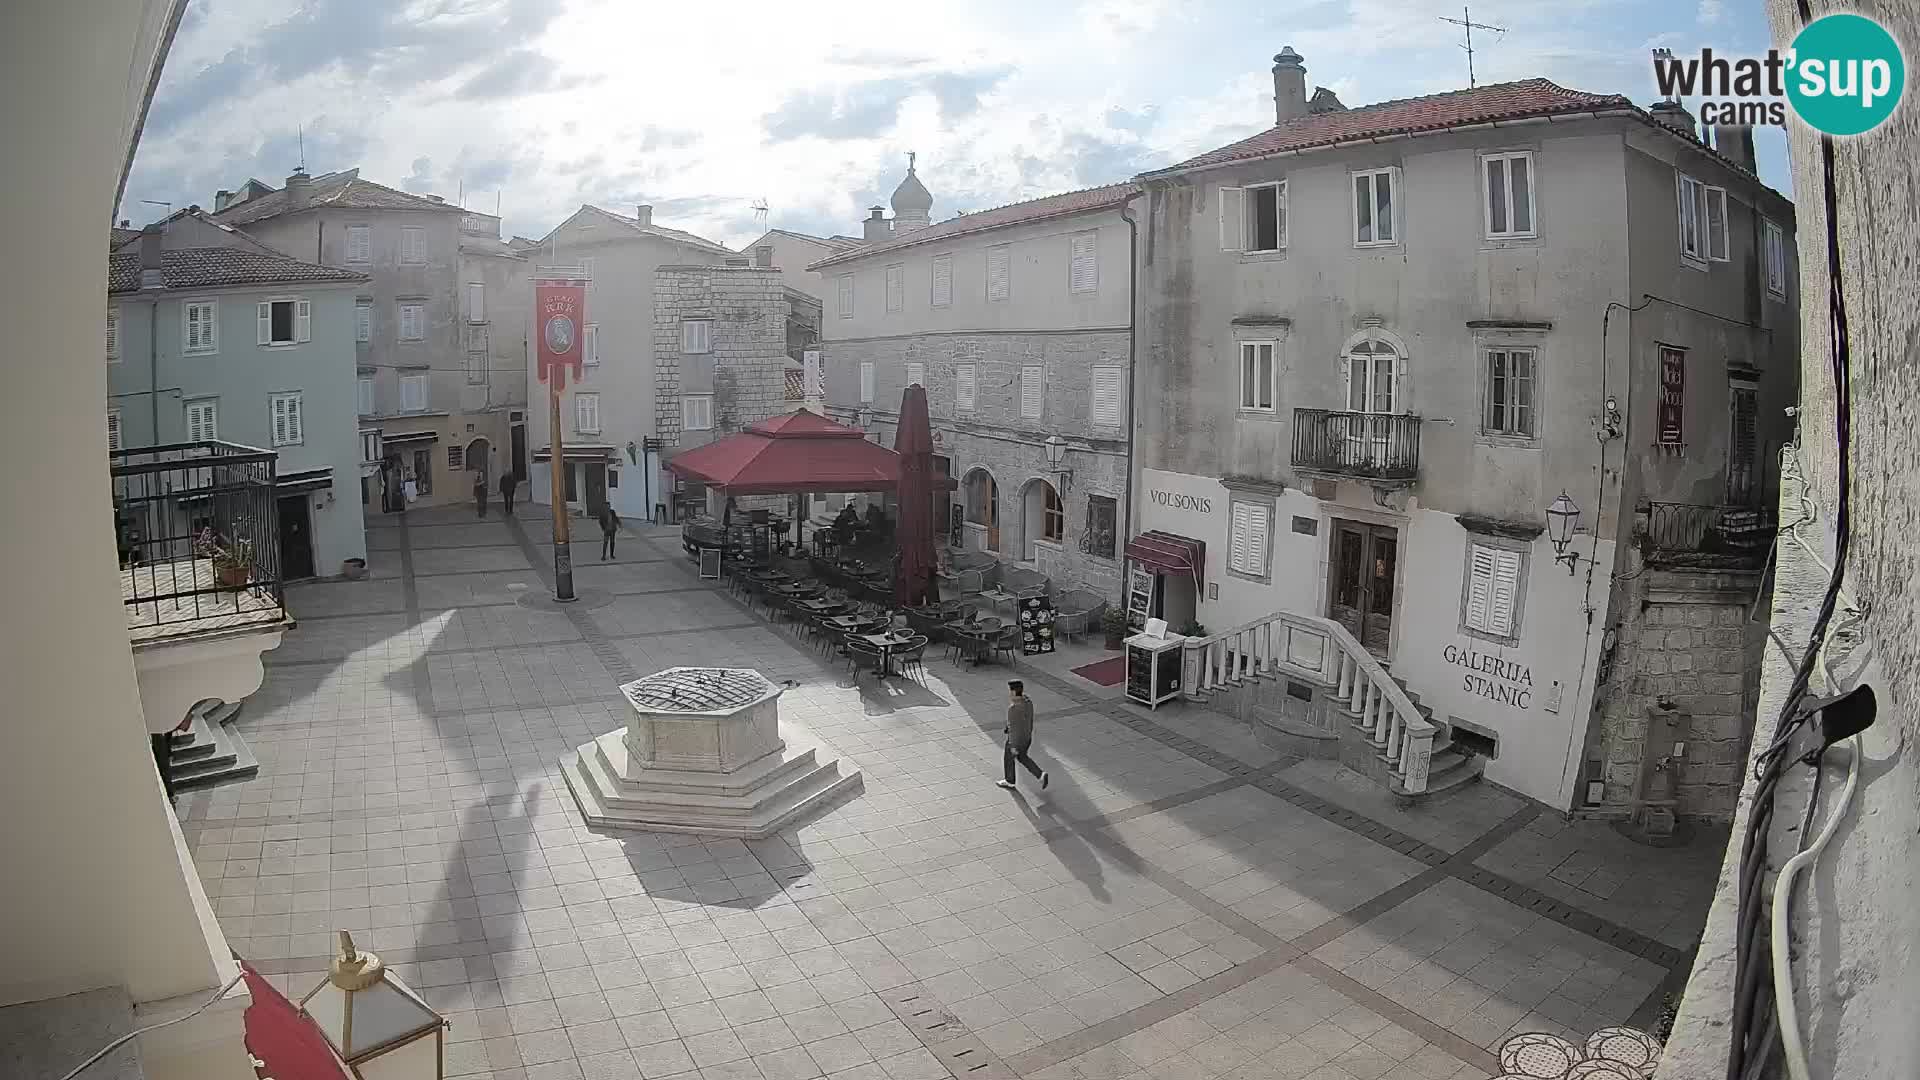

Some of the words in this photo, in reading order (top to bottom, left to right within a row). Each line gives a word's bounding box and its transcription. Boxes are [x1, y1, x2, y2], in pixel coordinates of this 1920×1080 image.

[545, 303, 575, 313] KRK
[1150, 489, 1212, 514] VOLSONIS
[1443, 644, 1533, 687] GALERIJA
[1463, 674, 1532, 710] STANIĆ
